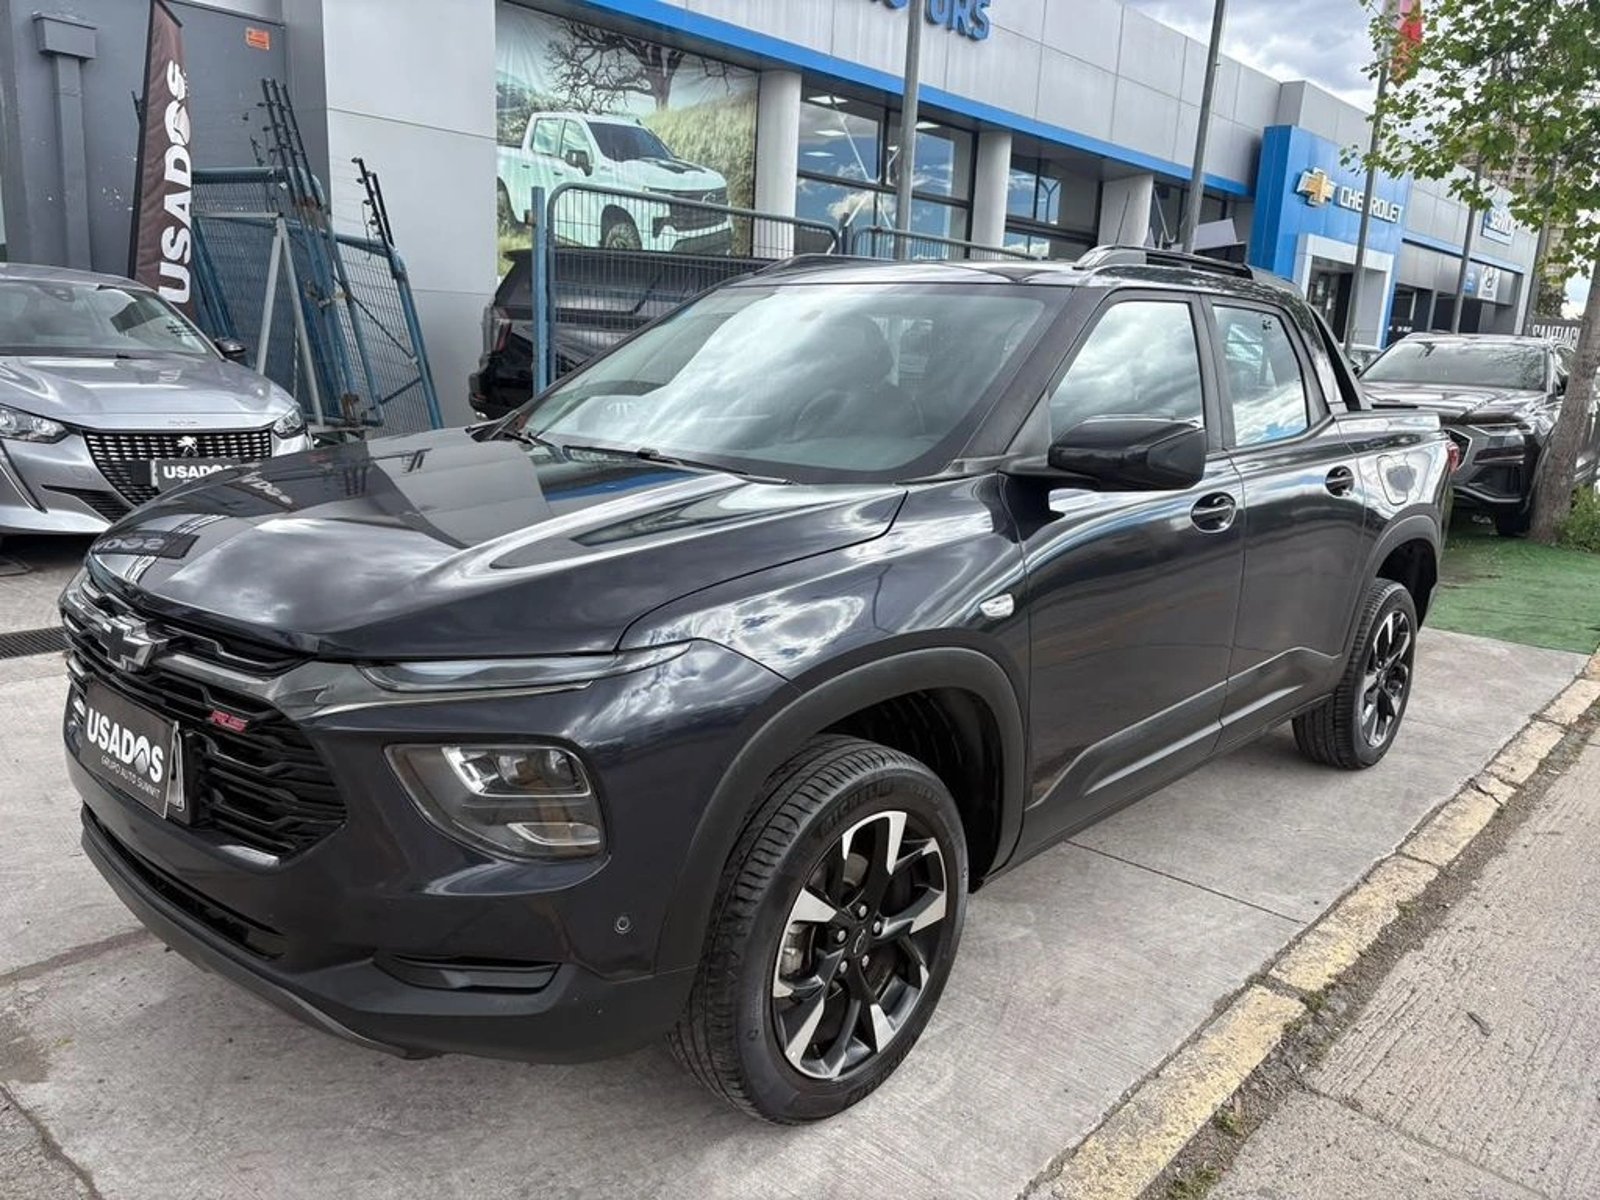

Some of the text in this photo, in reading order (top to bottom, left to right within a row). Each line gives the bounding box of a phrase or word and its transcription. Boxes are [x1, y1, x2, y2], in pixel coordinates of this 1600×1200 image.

[158, 60, 192, 304] USADOS
[1340, 186, 1404, 224] CHEROLET
[163, 465, 233, 479] USAD
[211, 709, 249, 733] RS
[86, 708, 164, 782] USADOS
